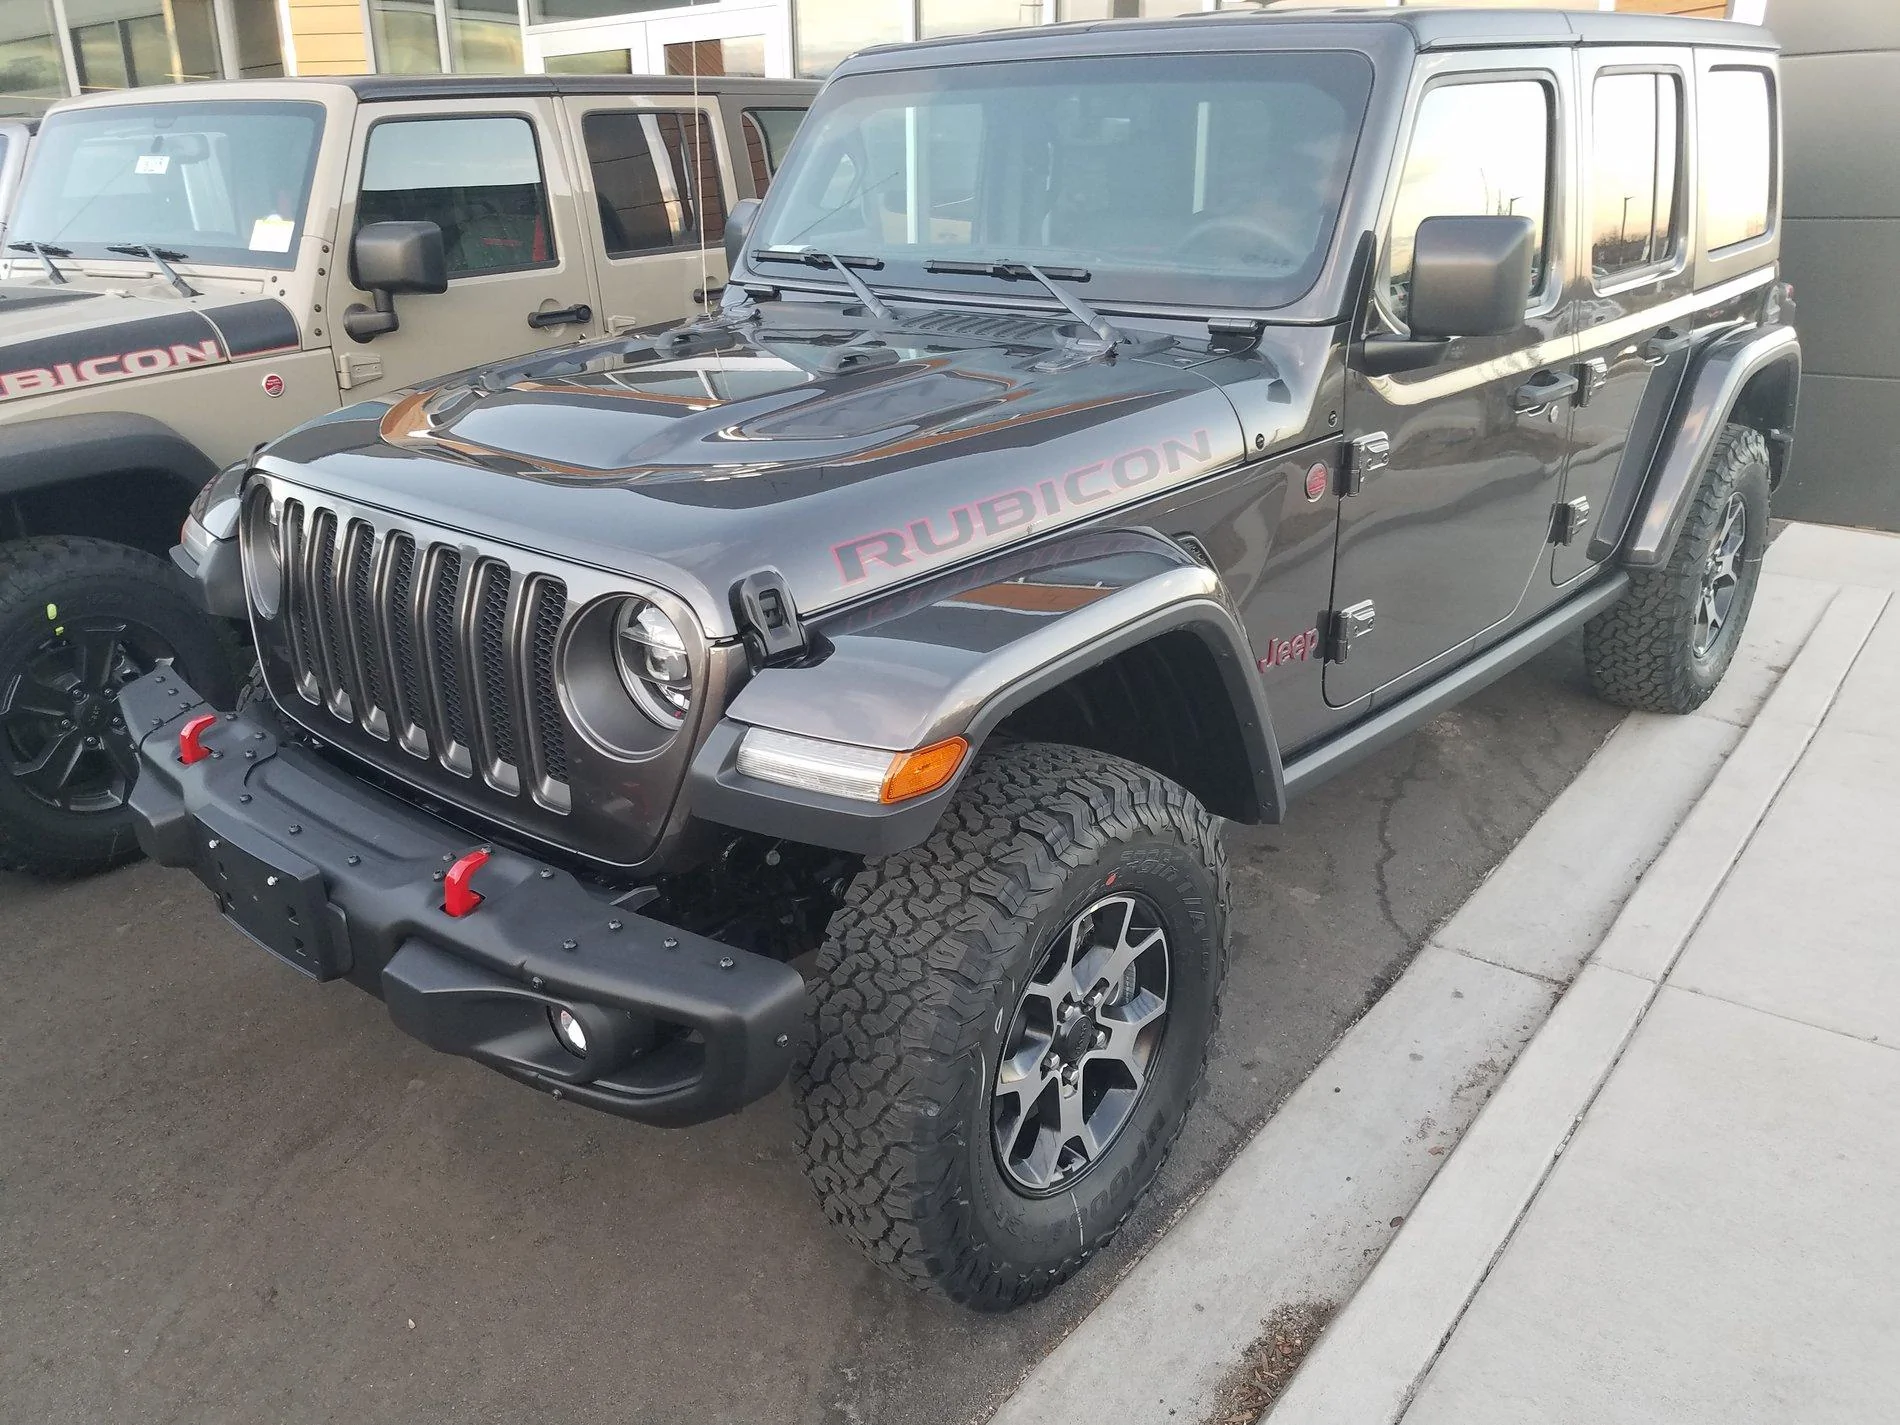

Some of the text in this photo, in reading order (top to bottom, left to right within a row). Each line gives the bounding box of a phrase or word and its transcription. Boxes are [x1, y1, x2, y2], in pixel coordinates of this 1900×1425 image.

[0, 340, 220, 398] BICON
[831, 430, 1213, 584] RUBICON
[1258, 628, 1319, 674] Jeep
